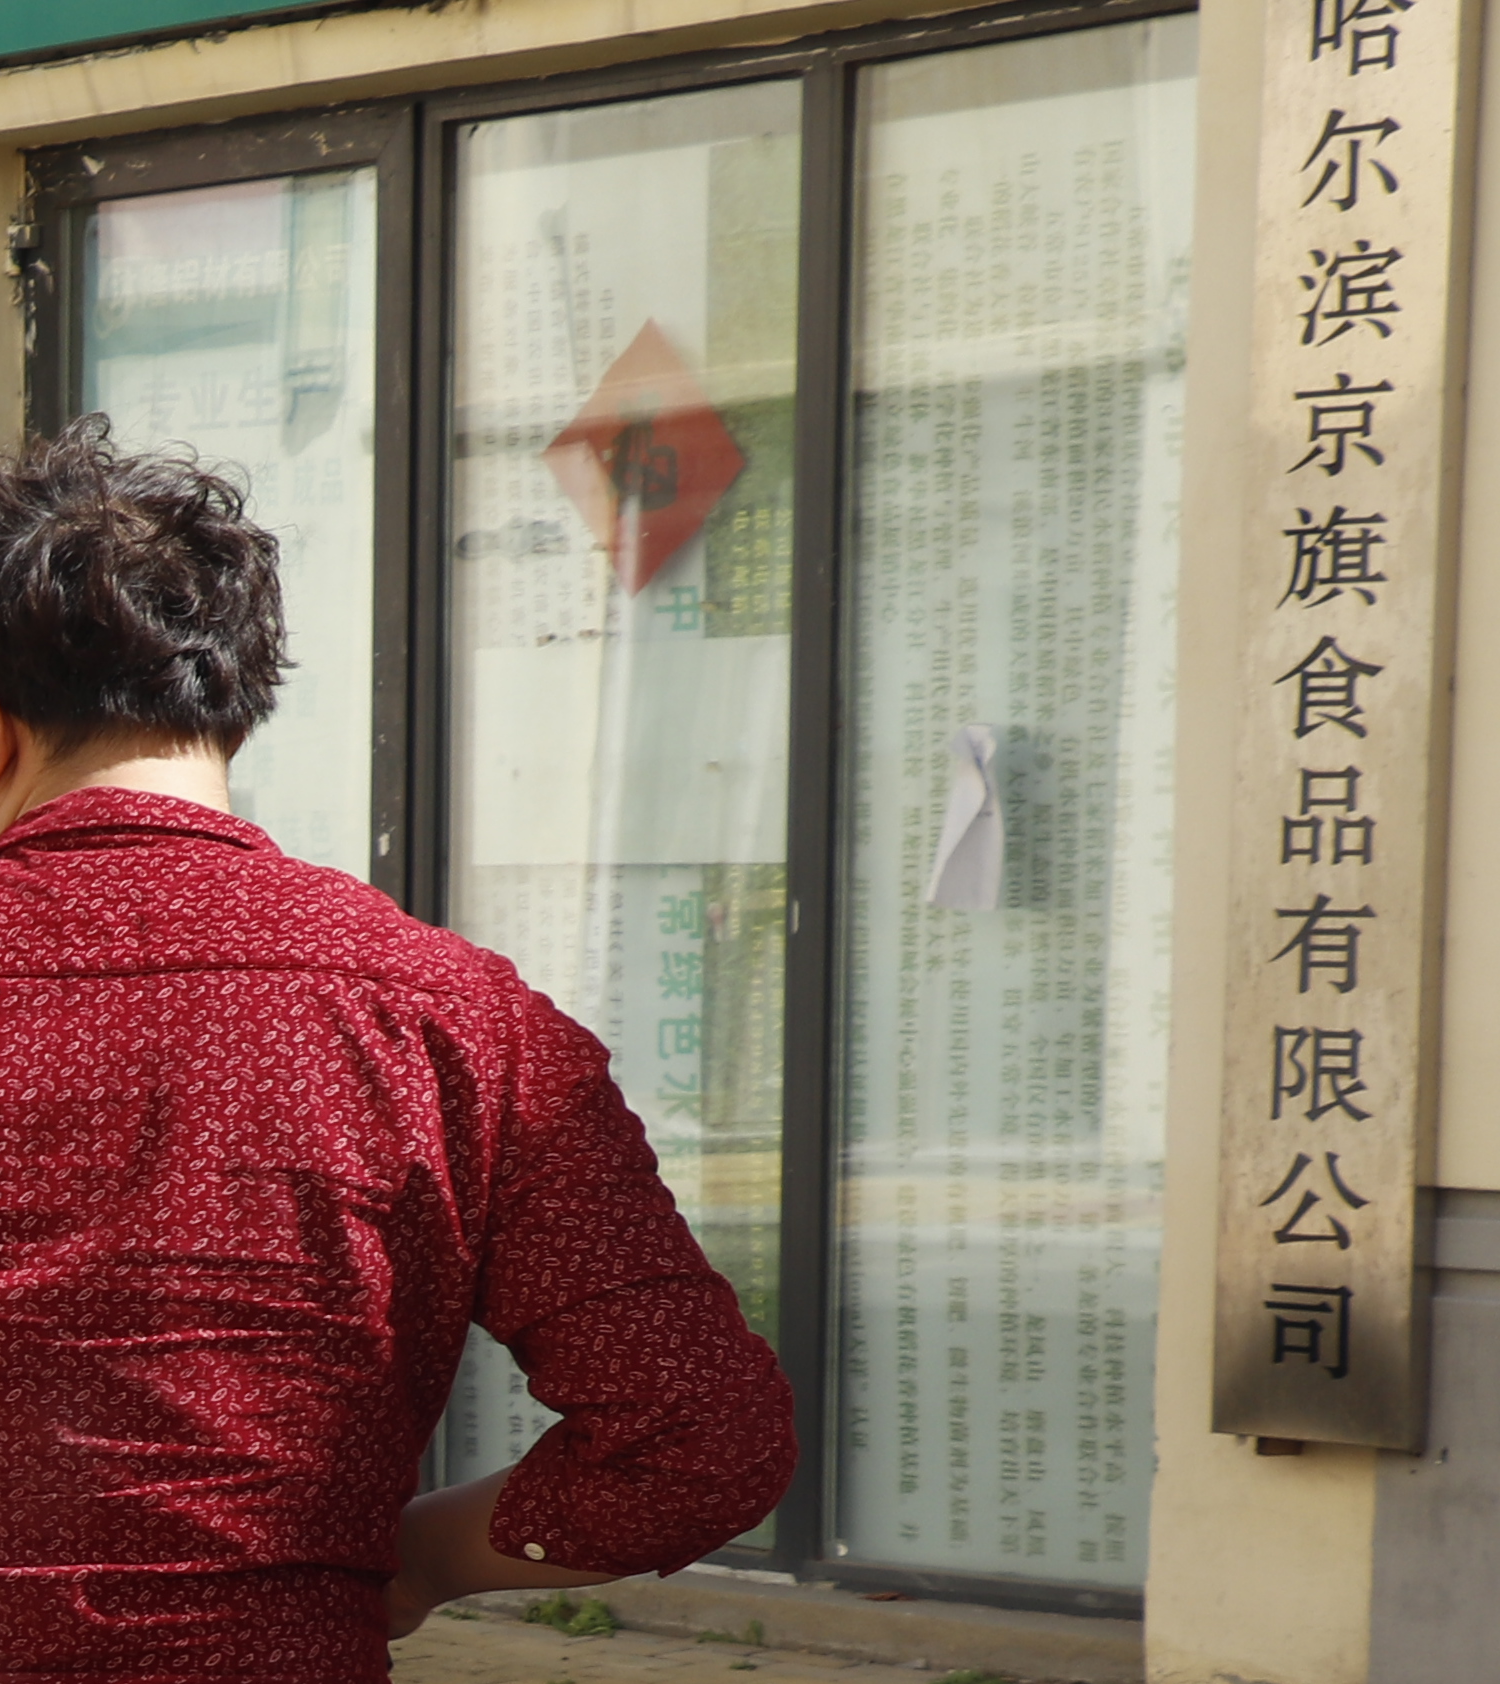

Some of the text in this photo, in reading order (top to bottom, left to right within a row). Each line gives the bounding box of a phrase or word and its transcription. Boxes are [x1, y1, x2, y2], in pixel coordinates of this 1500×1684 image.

[1259, 0, 1414, 1380] 哈尔滨京旗食品有限公司
